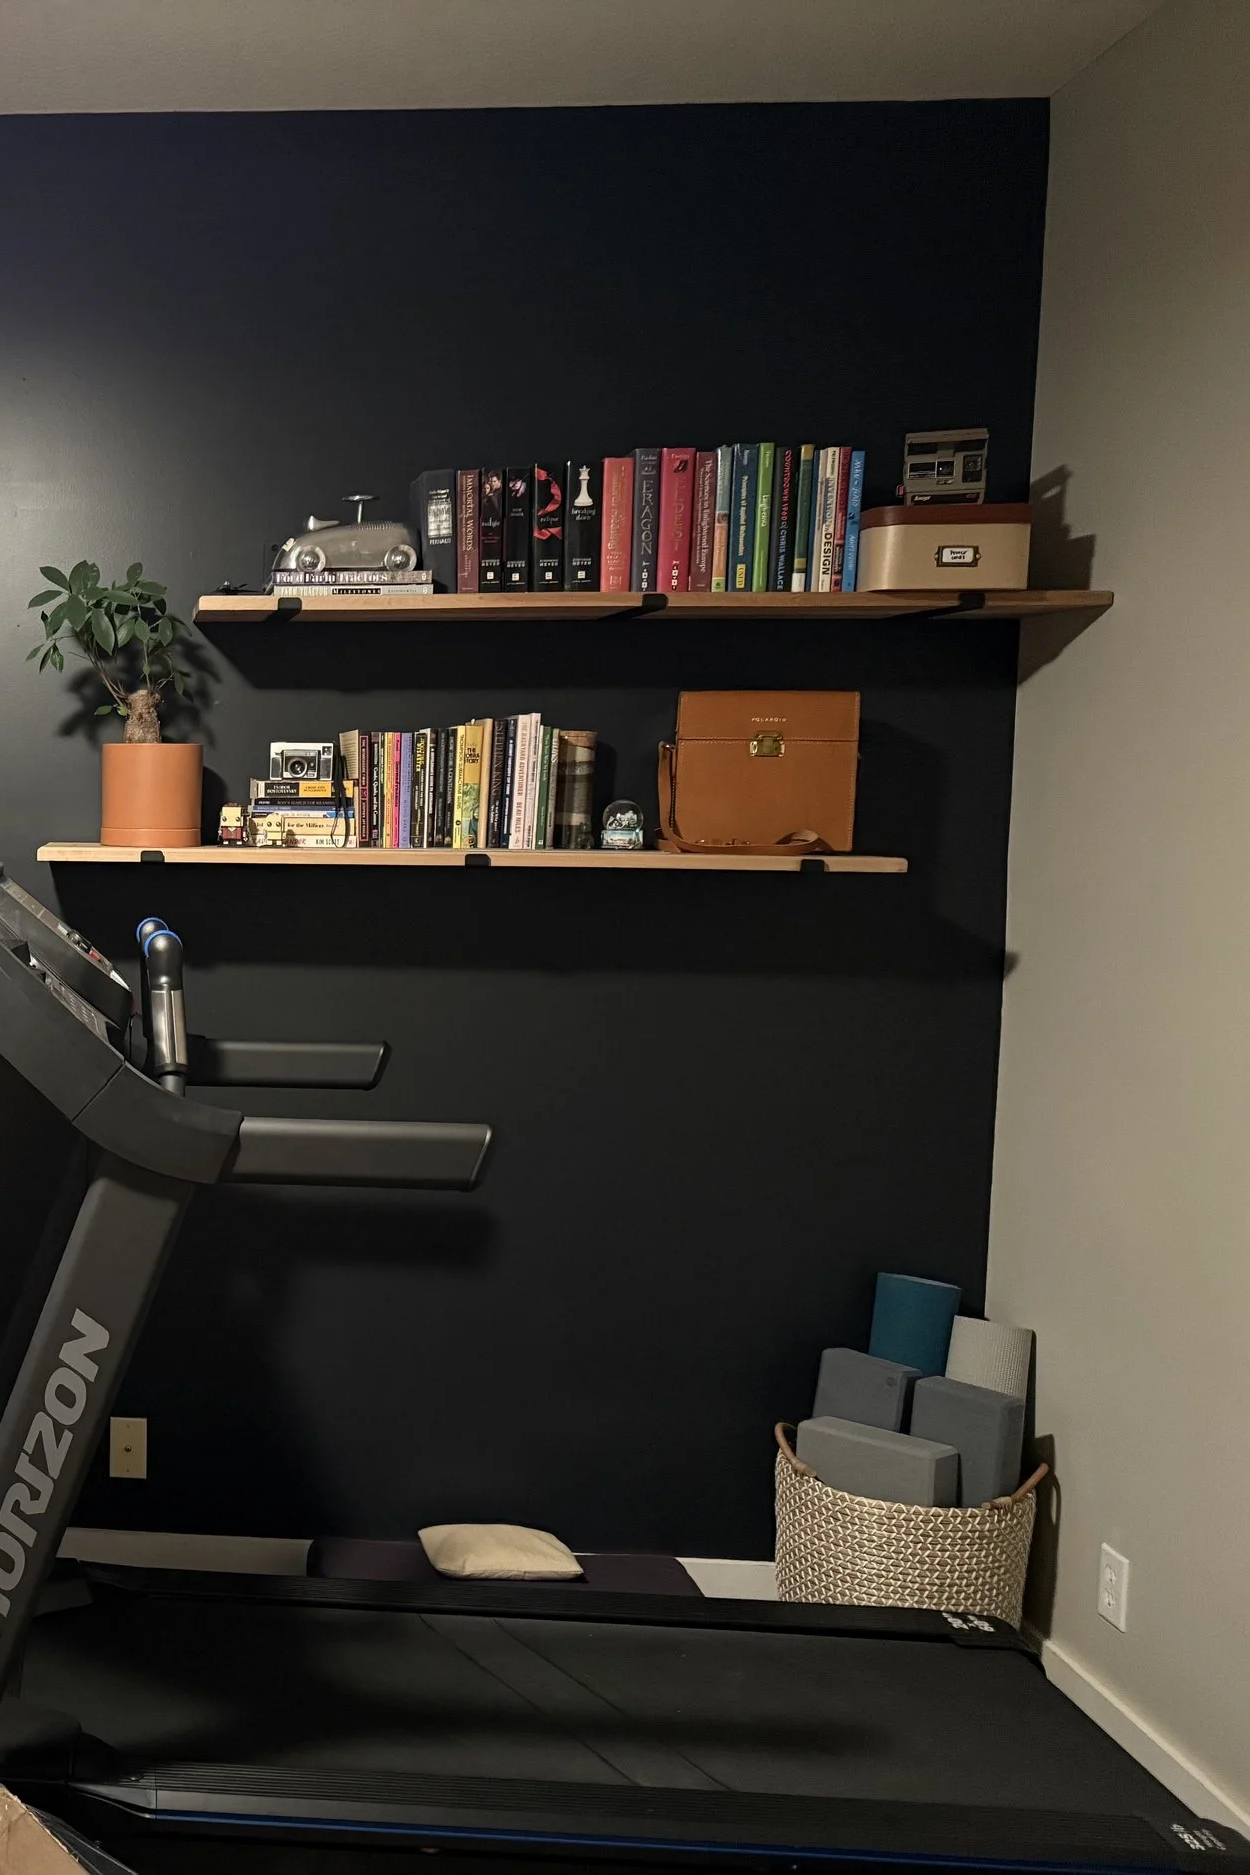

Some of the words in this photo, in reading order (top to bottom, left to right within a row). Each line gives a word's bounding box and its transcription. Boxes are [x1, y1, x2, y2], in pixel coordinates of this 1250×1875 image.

[703, 474, 711, 500] Sciences
[782, 450, 791, 502] COUNTDOWN
[466, 475, 474, 518] IMMORTAL
[572, 507, 596, 515] breaking
[781, 503, 789, 521] 1960
[641, 480, 653, 555] ERAGON
[701, 510, 709, 548] Enlightened
[779, 530, 787, 553] CHRIS
[822, 533, 832, 575] DESIGN
[700, 549, 708, 573] Europe
[777, 554, 785, 590] WALLACE
[276, 573, 303, 582] Ford
[305, 573, 336, 582] Farm
[340, 572, 387, 582] Tractors
[493, 722, 503, 769] STEPHEN
[519, 733, 527, 761] BACKYARD
[492, 771, 501, 796] KING
[517, 762, 525, 796] ADVENTURER
